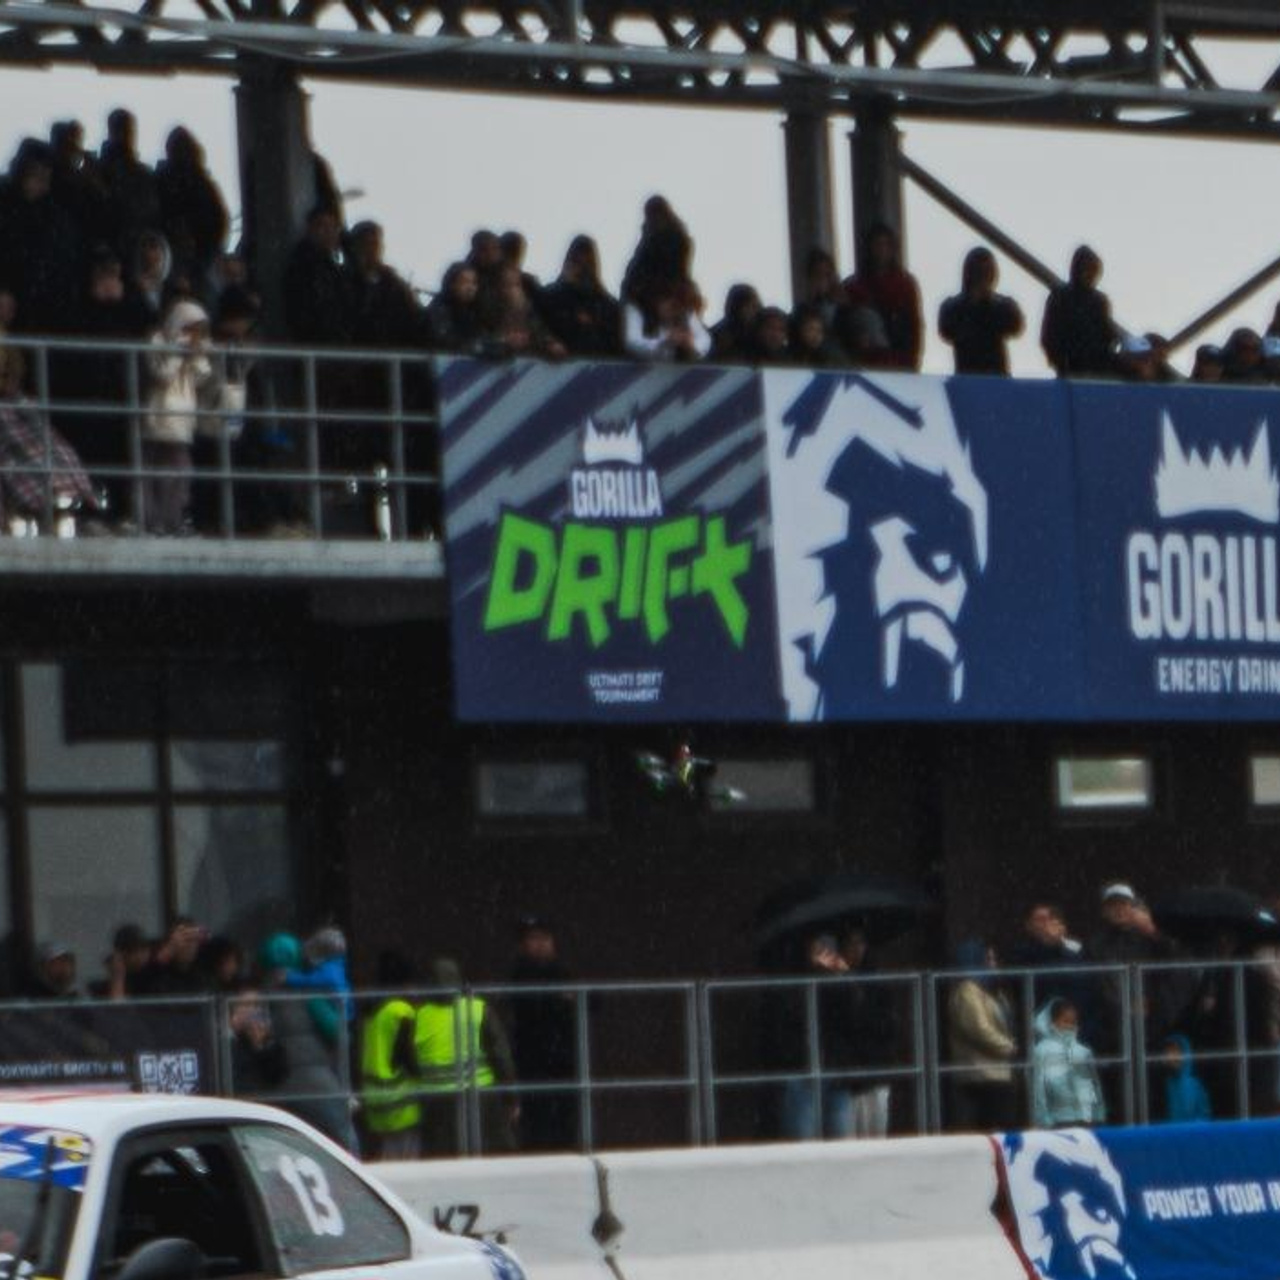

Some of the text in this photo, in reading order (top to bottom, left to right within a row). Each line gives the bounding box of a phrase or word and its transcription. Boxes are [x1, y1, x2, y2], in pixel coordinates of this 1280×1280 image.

[572, 469, 663, 518] GORILLA
[484, 513, 752, 649] DRIFT
[1158, 657, 1233, 693] ENERGY
[279, 1154, 345, 1237] 13
[1142, 1187, 1212, 1221] POWER
[1214, 1182, 1266, 1215] YOUR
